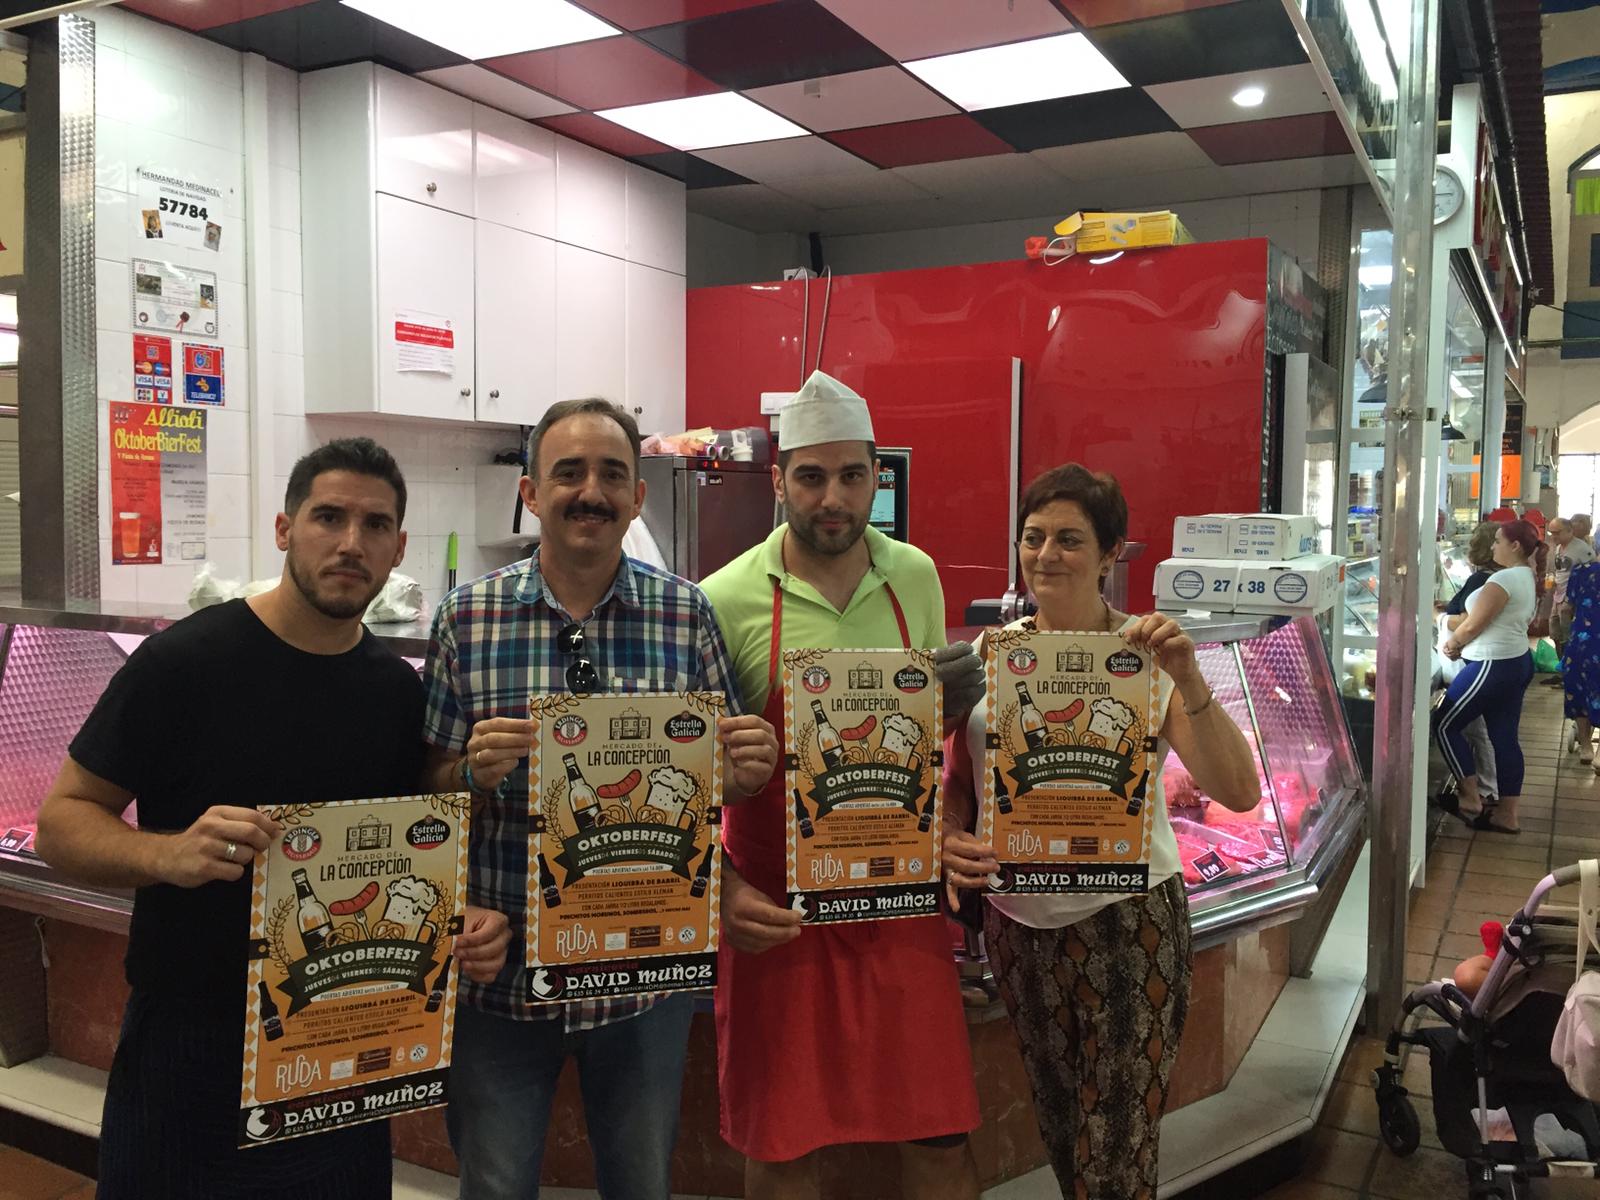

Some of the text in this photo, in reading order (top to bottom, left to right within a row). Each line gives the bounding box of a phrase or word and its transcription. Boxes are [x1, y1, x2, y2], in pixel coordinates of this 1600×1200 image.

[142, 171, 184, 187] HERMANDAD
[159, 197, 208, 220] 57784
[1213, 580, 1231, 592] 27
[1248, 581, 1265, 593] 38
[1110, 656, 1139, 664] Estrella
[898, 672, 924, 680] Estrella
[900, 680, 924, 688] Galicia
[1037, 678, 1110, 695] LA CONCEPCIÓN
[832, 694, 900, 712] LA CONCEPCIÓN
[555, 715, 586, 729] ERDINGER
[670, 719, 702, 728] Estrella
[671, 728, 700, 738] Galicia
[588, 745, 670, 766] LA CONCEPCIÓN
[1028, 751, 1120, 770] OKTOBERFEST
[826, 770, 911, 787] OKTOBERFEST
[285, 826, 319, 842] ERDINGER
[412, 824, 446, 836] Estrella
[413, 834, 444, 844] Galicia
[577, 830, 682, 851] OKTOBERFEST
[1008, 829, 1043, 857] RUDA
[320, 864, 335, 882] LA
[339, 854, 411, 880] CONCEPCIÓN
[811, 853, 844, 885] RUDA
[1015, 873, 1071, 886] DAVID
[818, 898, 870, 914] DAVID
[556, 922, 598, 958] RUDA
[304, 947, 421, 975] OKTOBERFEST
[566, 971, 630, 990] DAVID
[379, 998, 389, 1006] DE
[276, 1054, 322, 1094] RUDA
[284, 1101, 355, 1127] DAVID
